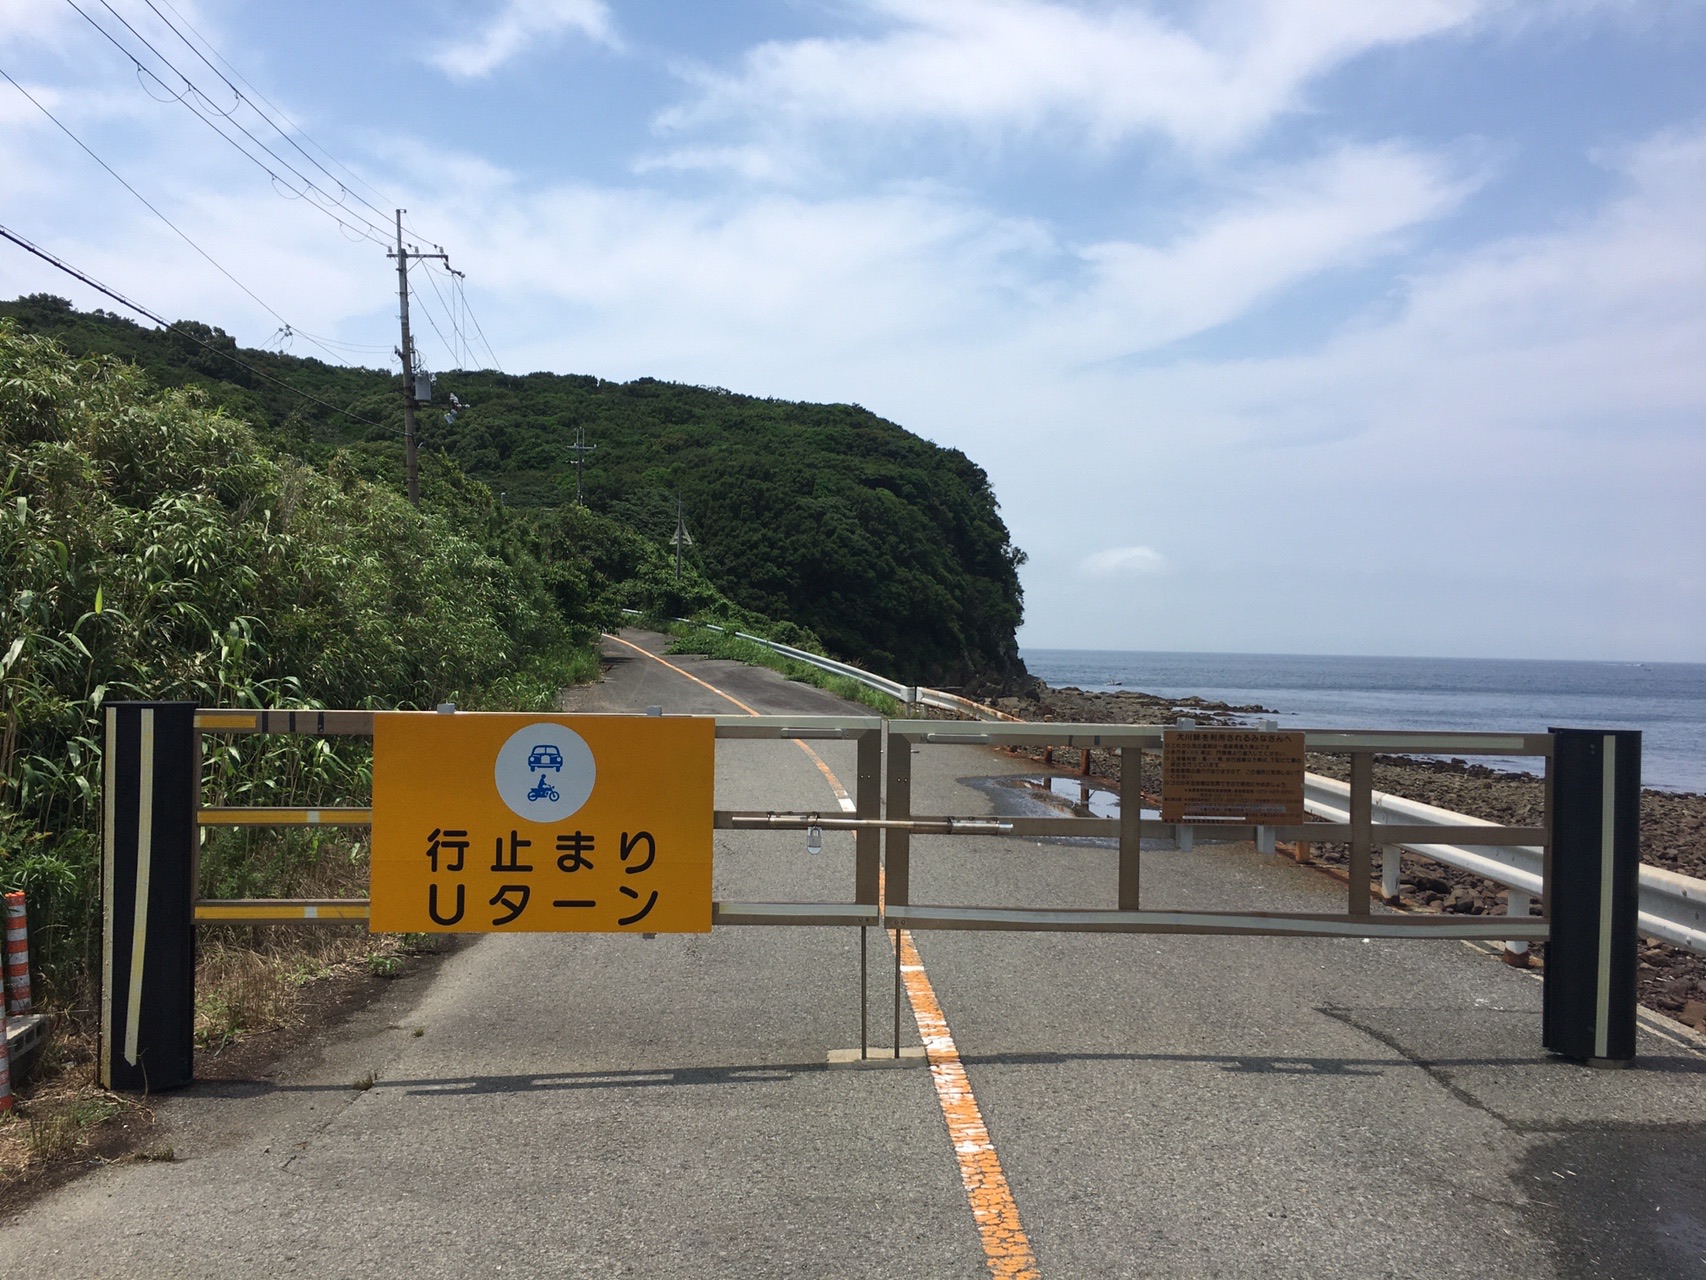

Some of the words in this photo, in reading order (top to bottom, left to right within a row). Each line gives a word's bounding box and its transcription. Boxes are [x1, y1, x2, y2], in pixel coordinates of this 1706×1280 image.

[426, 828, 656, 874] 行止まり
[428, 883, 659, 926] Uターン
